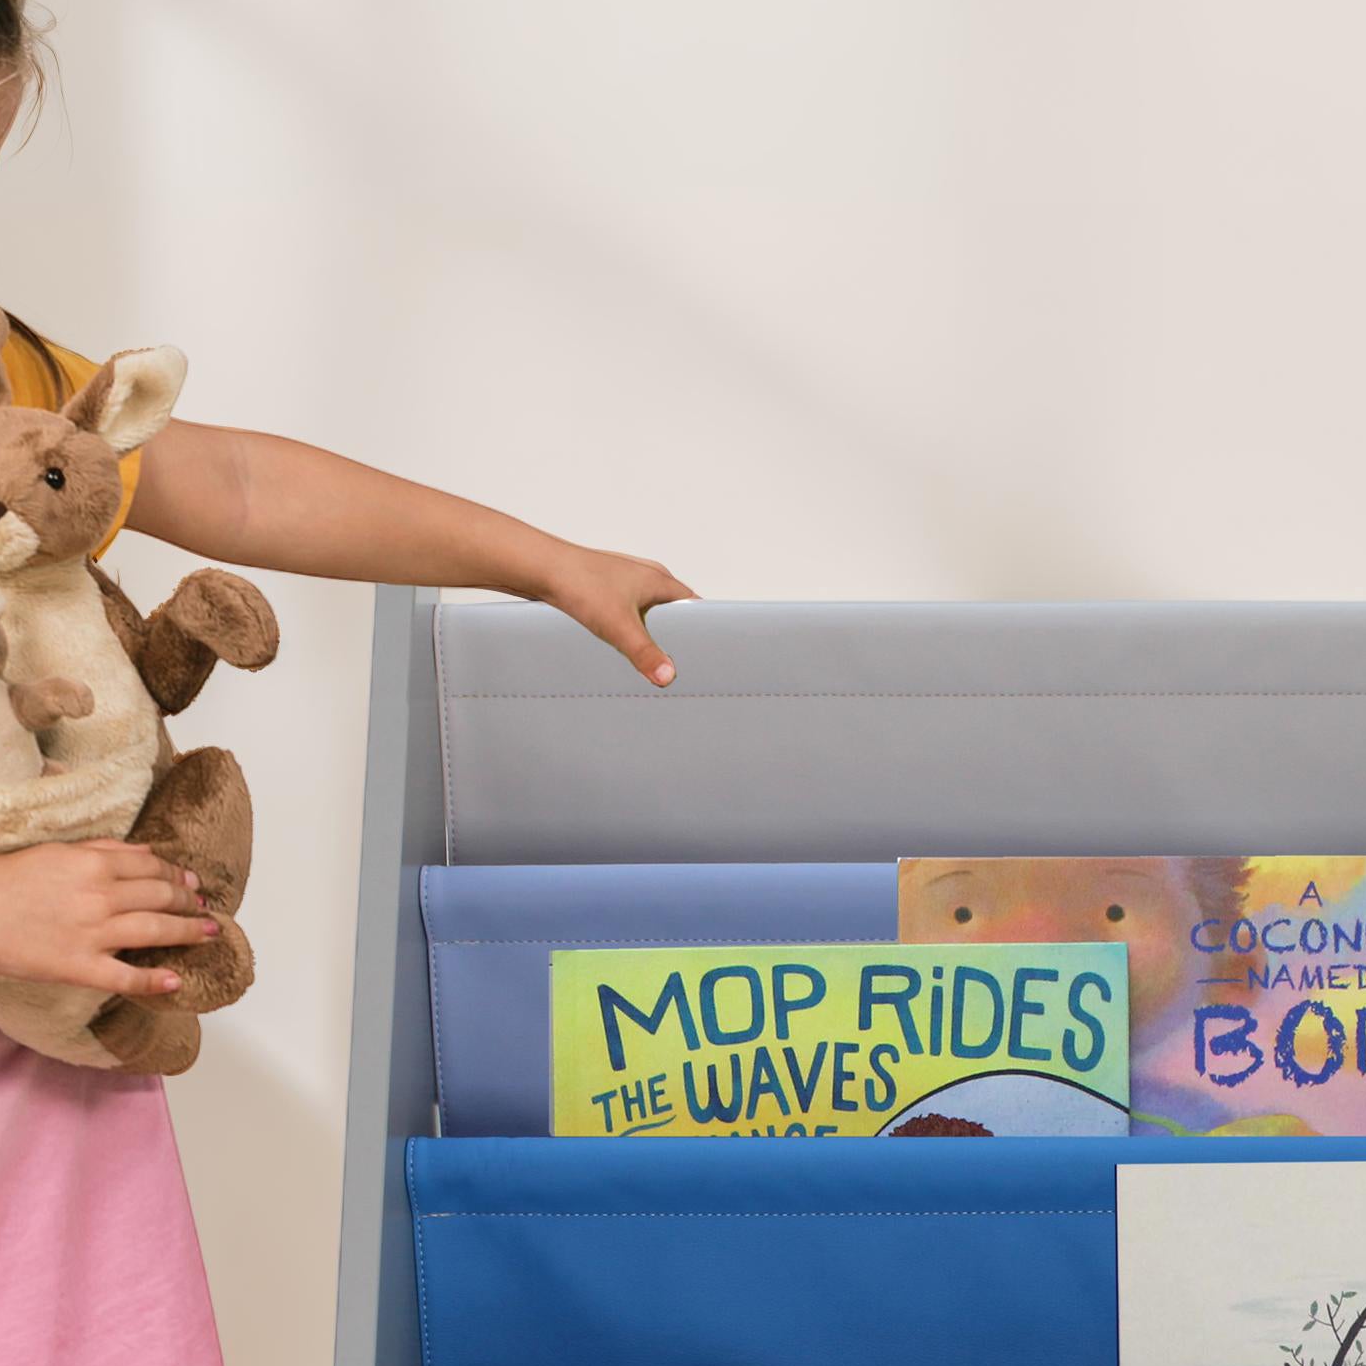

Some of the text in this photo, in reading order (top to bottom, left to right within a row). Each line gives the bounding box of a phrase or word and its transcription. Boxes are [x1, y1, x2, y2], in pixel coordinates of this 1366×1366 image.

[1299, 881, 1323, 907] A
[597, 964, 827, 1071] MOP
[591, 1041, 900, 1133] THE WAVES
